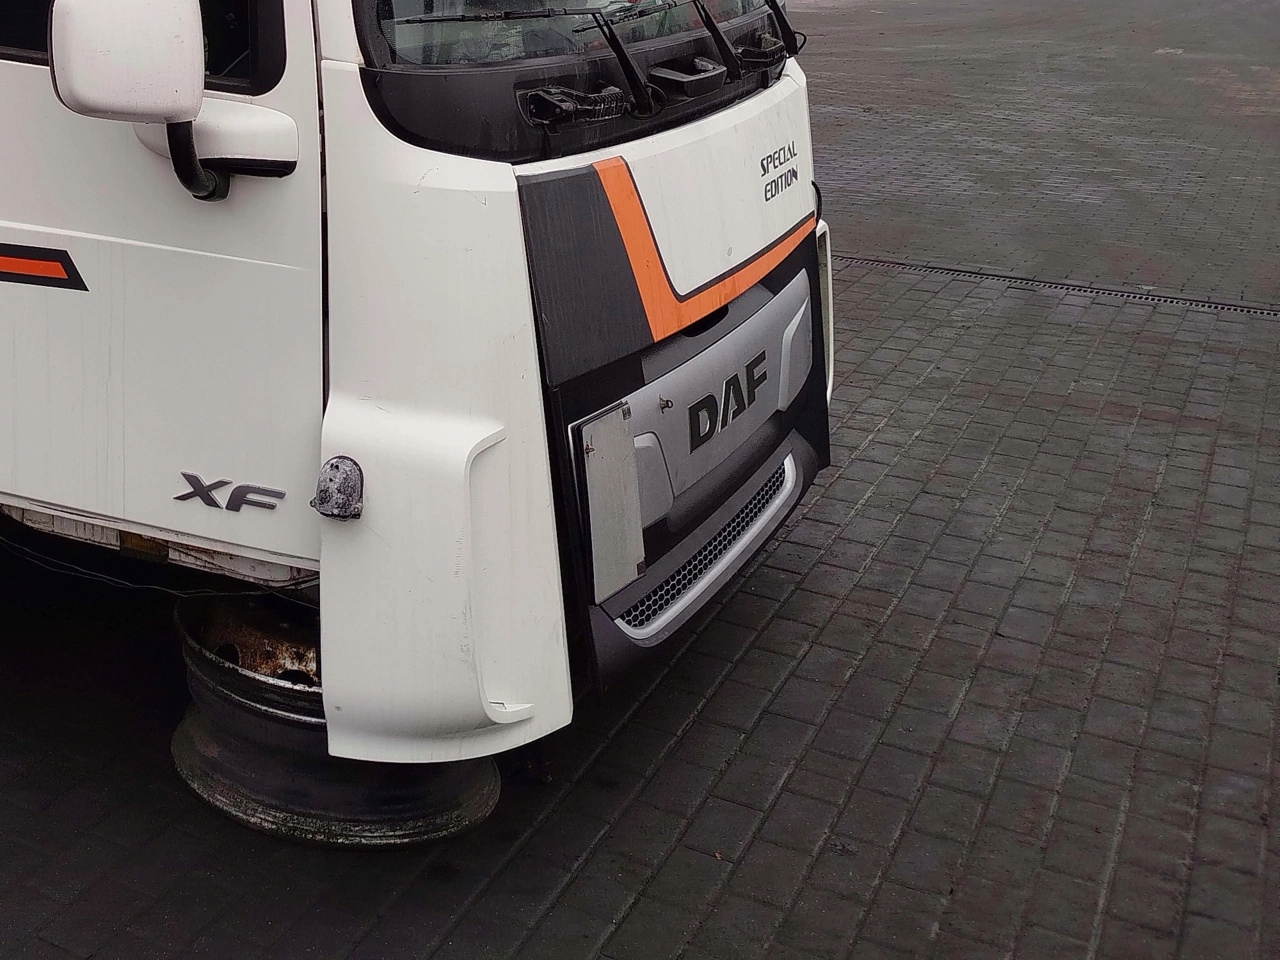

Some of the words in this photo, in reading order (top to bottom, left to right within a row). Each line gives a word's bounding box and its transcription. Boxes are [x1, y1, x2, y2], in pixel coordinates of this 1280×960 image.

[760, 140, 798, 178] SPECIAL
[764, 163, 798, 203] EDITION
[688, 348, 768, 455] DAF
[173, 470, 287, 512] XF
